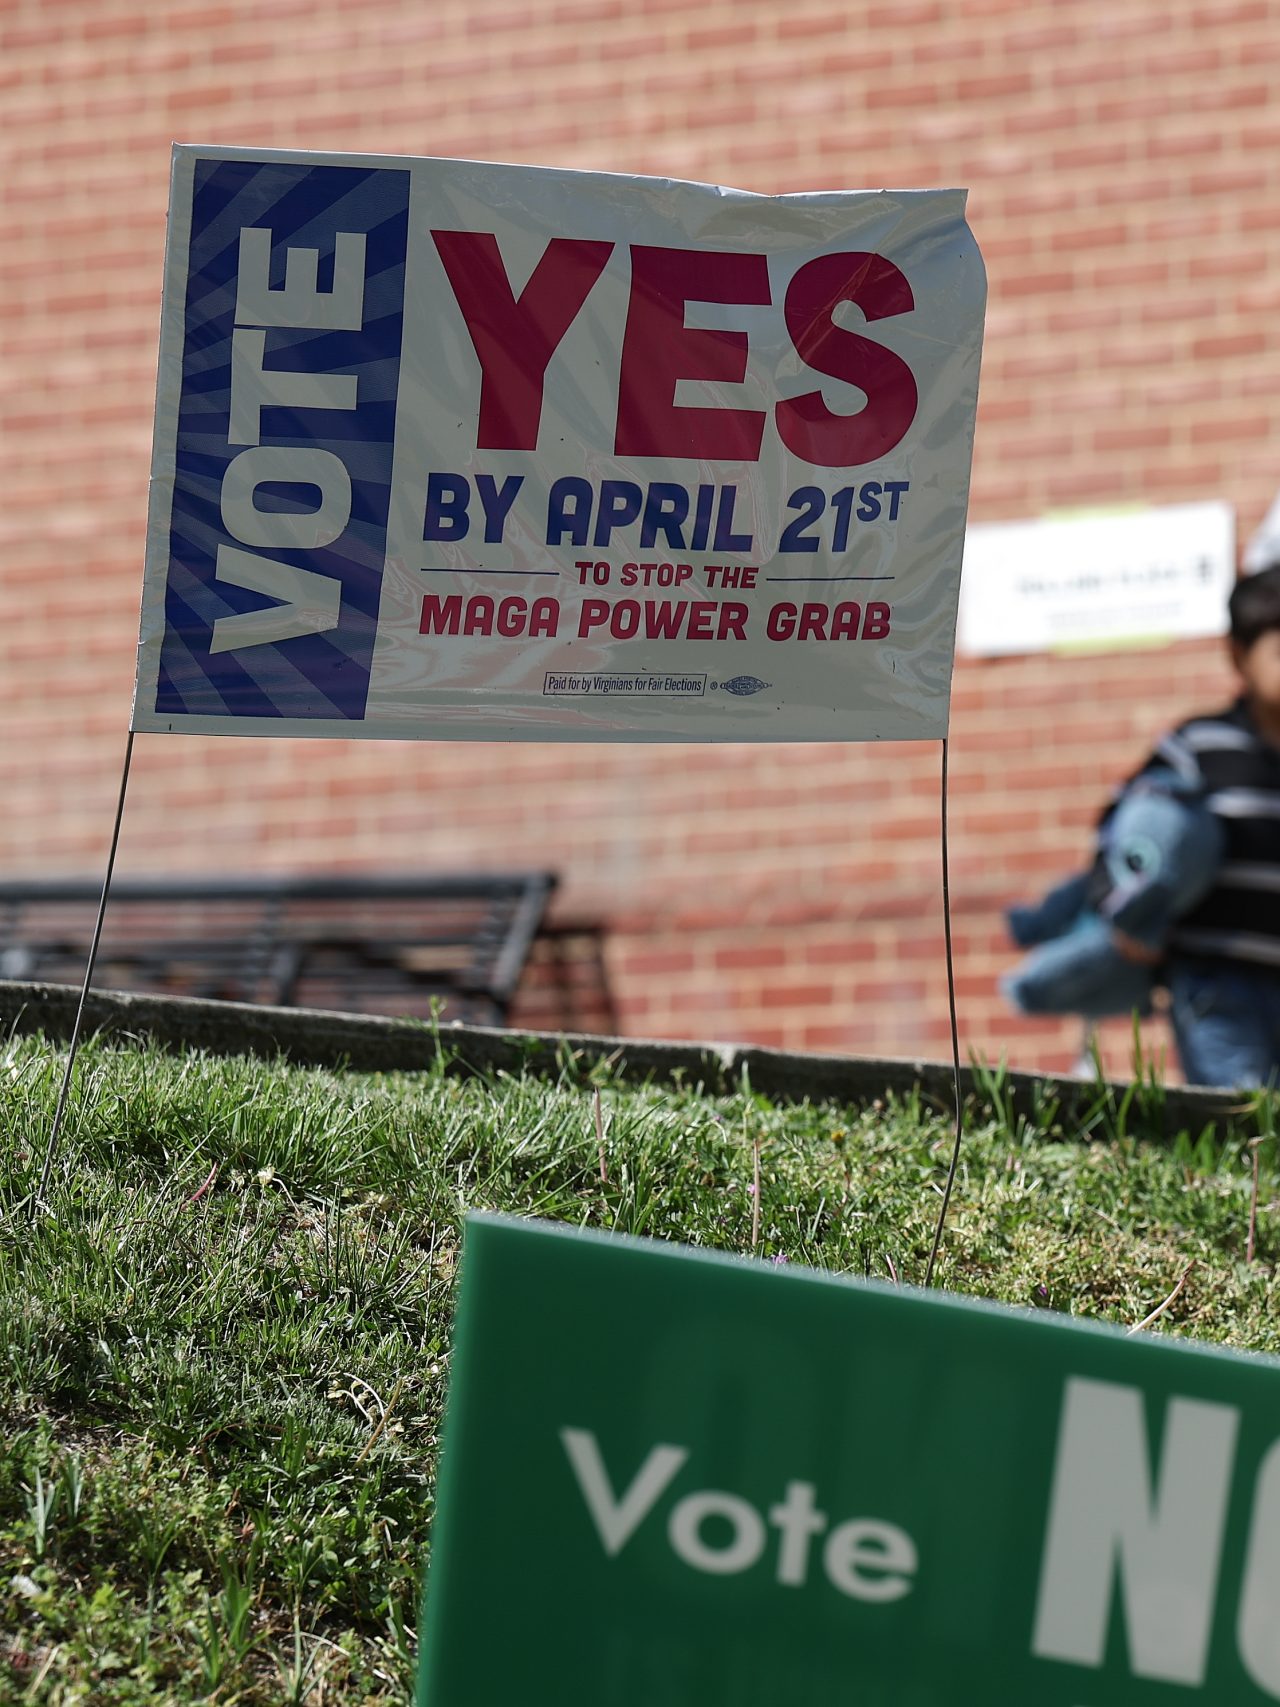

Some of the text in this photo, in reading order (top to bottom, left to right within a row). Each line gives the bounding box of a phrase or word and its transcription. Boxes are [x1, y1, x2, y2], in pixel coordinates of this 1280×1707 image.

[429, 229, 919, 468] YES
[210, 227, 367, 654] VOTE
[422, 472, 910, 553] BY APRIL 21ST
[575, 561, 759, 590] TO STOP THE
[418, 594, 892, 641] MAGA POWER GRAB
[548, 676, 702, 693] Paid for by Virginians for Fair Elections
[560, 1426, 919, 1603] Vote
